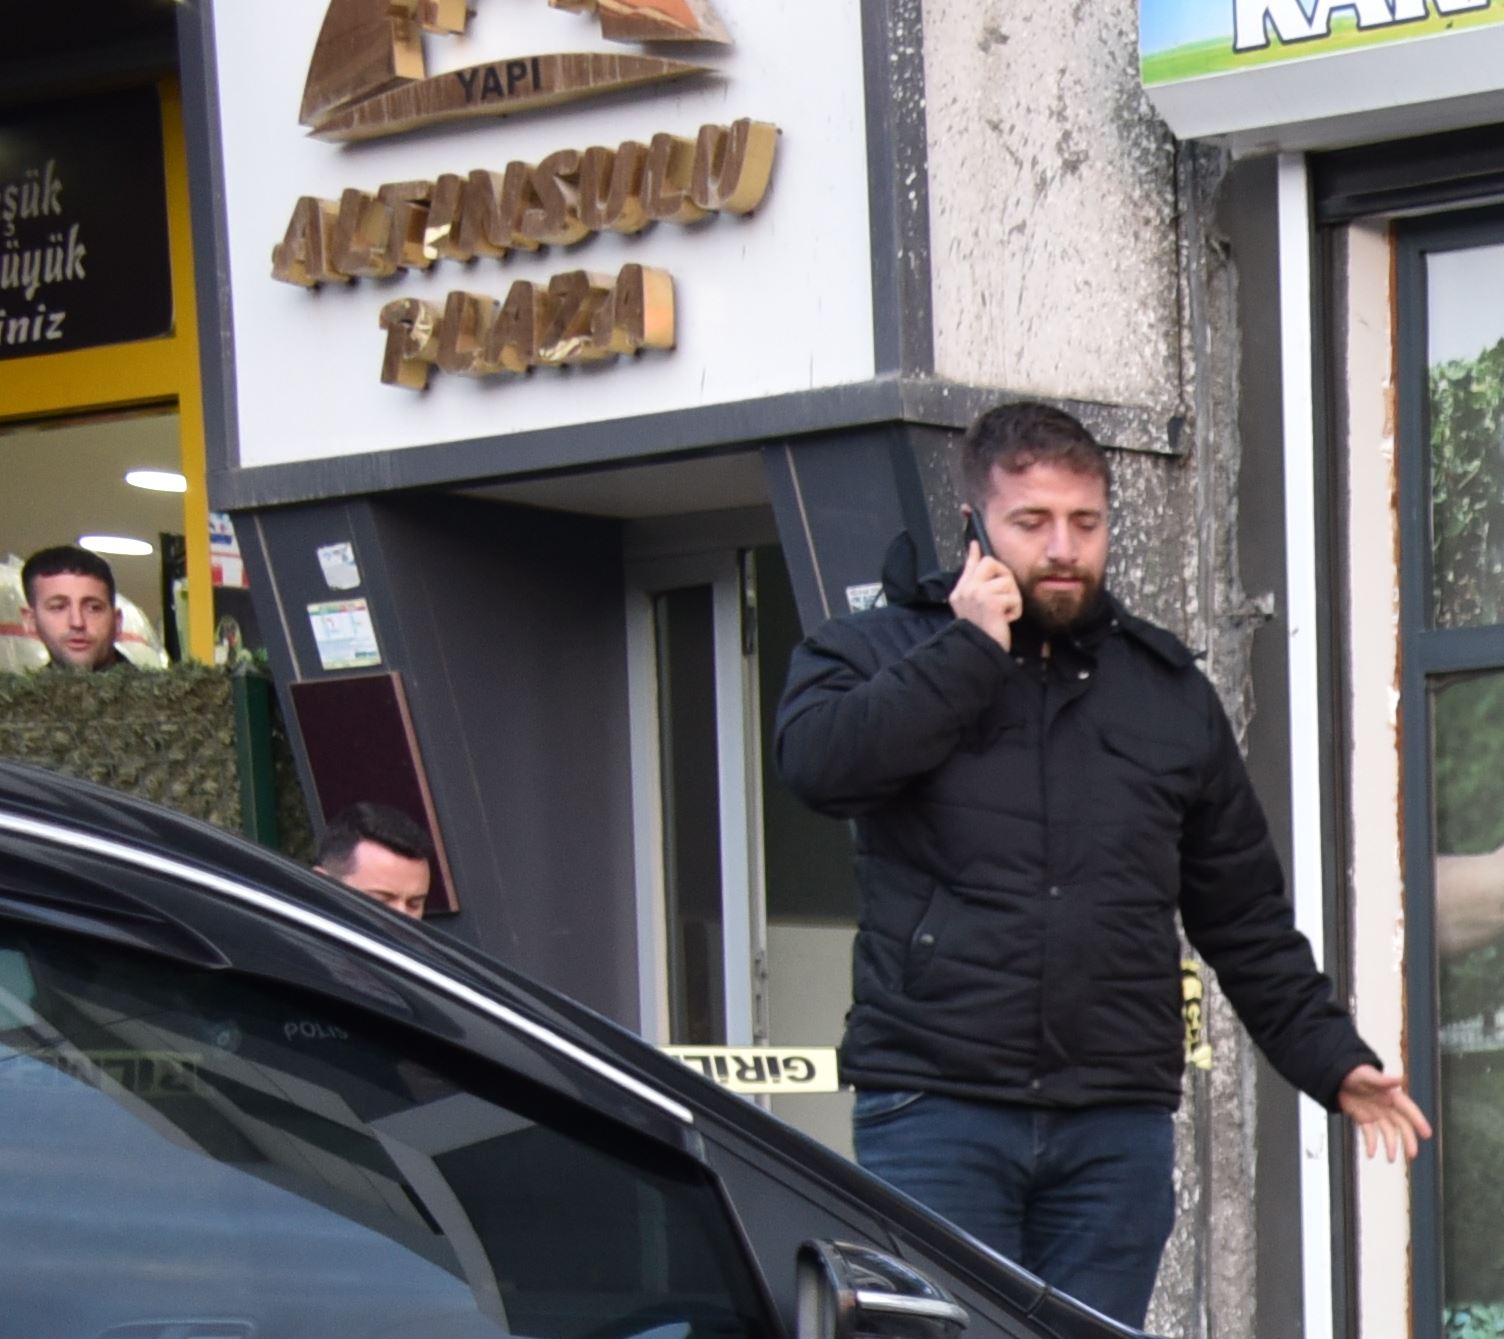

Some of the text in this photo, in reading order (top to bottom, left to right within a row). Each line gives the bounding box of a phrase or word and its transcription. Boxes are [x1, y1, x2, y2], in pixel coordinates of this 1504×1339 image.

[456, 58, 543, 104] YAPI
[0, 159, 63, 236] şük
[379, 263, 674, 389] PLAZA
